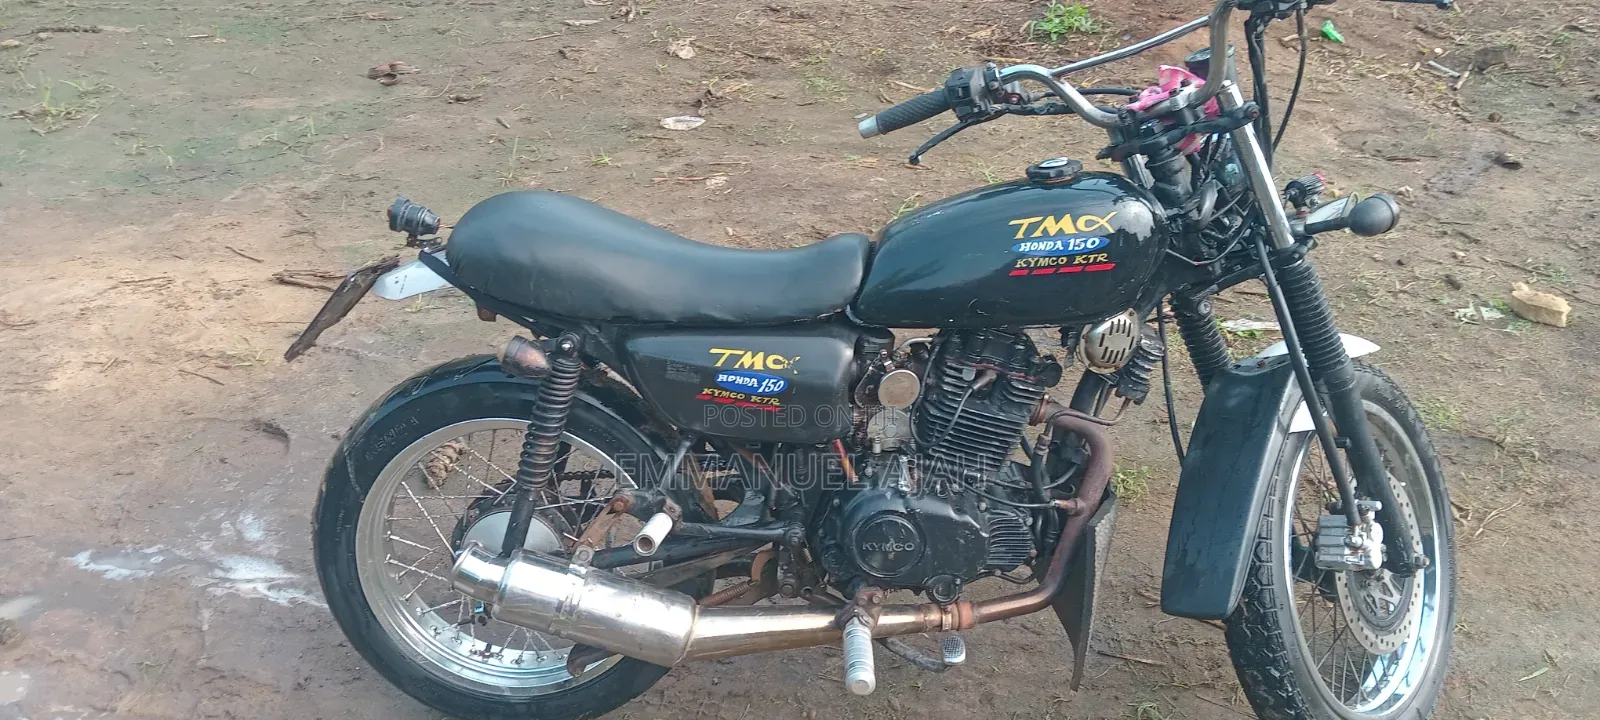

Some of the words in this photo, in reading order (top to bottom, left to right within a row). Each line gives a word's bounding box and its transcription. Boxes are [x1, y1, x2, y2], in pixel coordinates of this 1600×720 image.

[1018, 241, 1064, 252] HONDA
[1068, 237, 1101, 250] 150
[1014, 256, 1068, 268] KYMCO
[1073, 253, 1109, 265] KTR
[757, 378, 785, 393] 150
[701, 387, 746, 400] KYMCO
[750, 395, 781, 406] KTR
[861, 541, 915, 552] KYMCO
